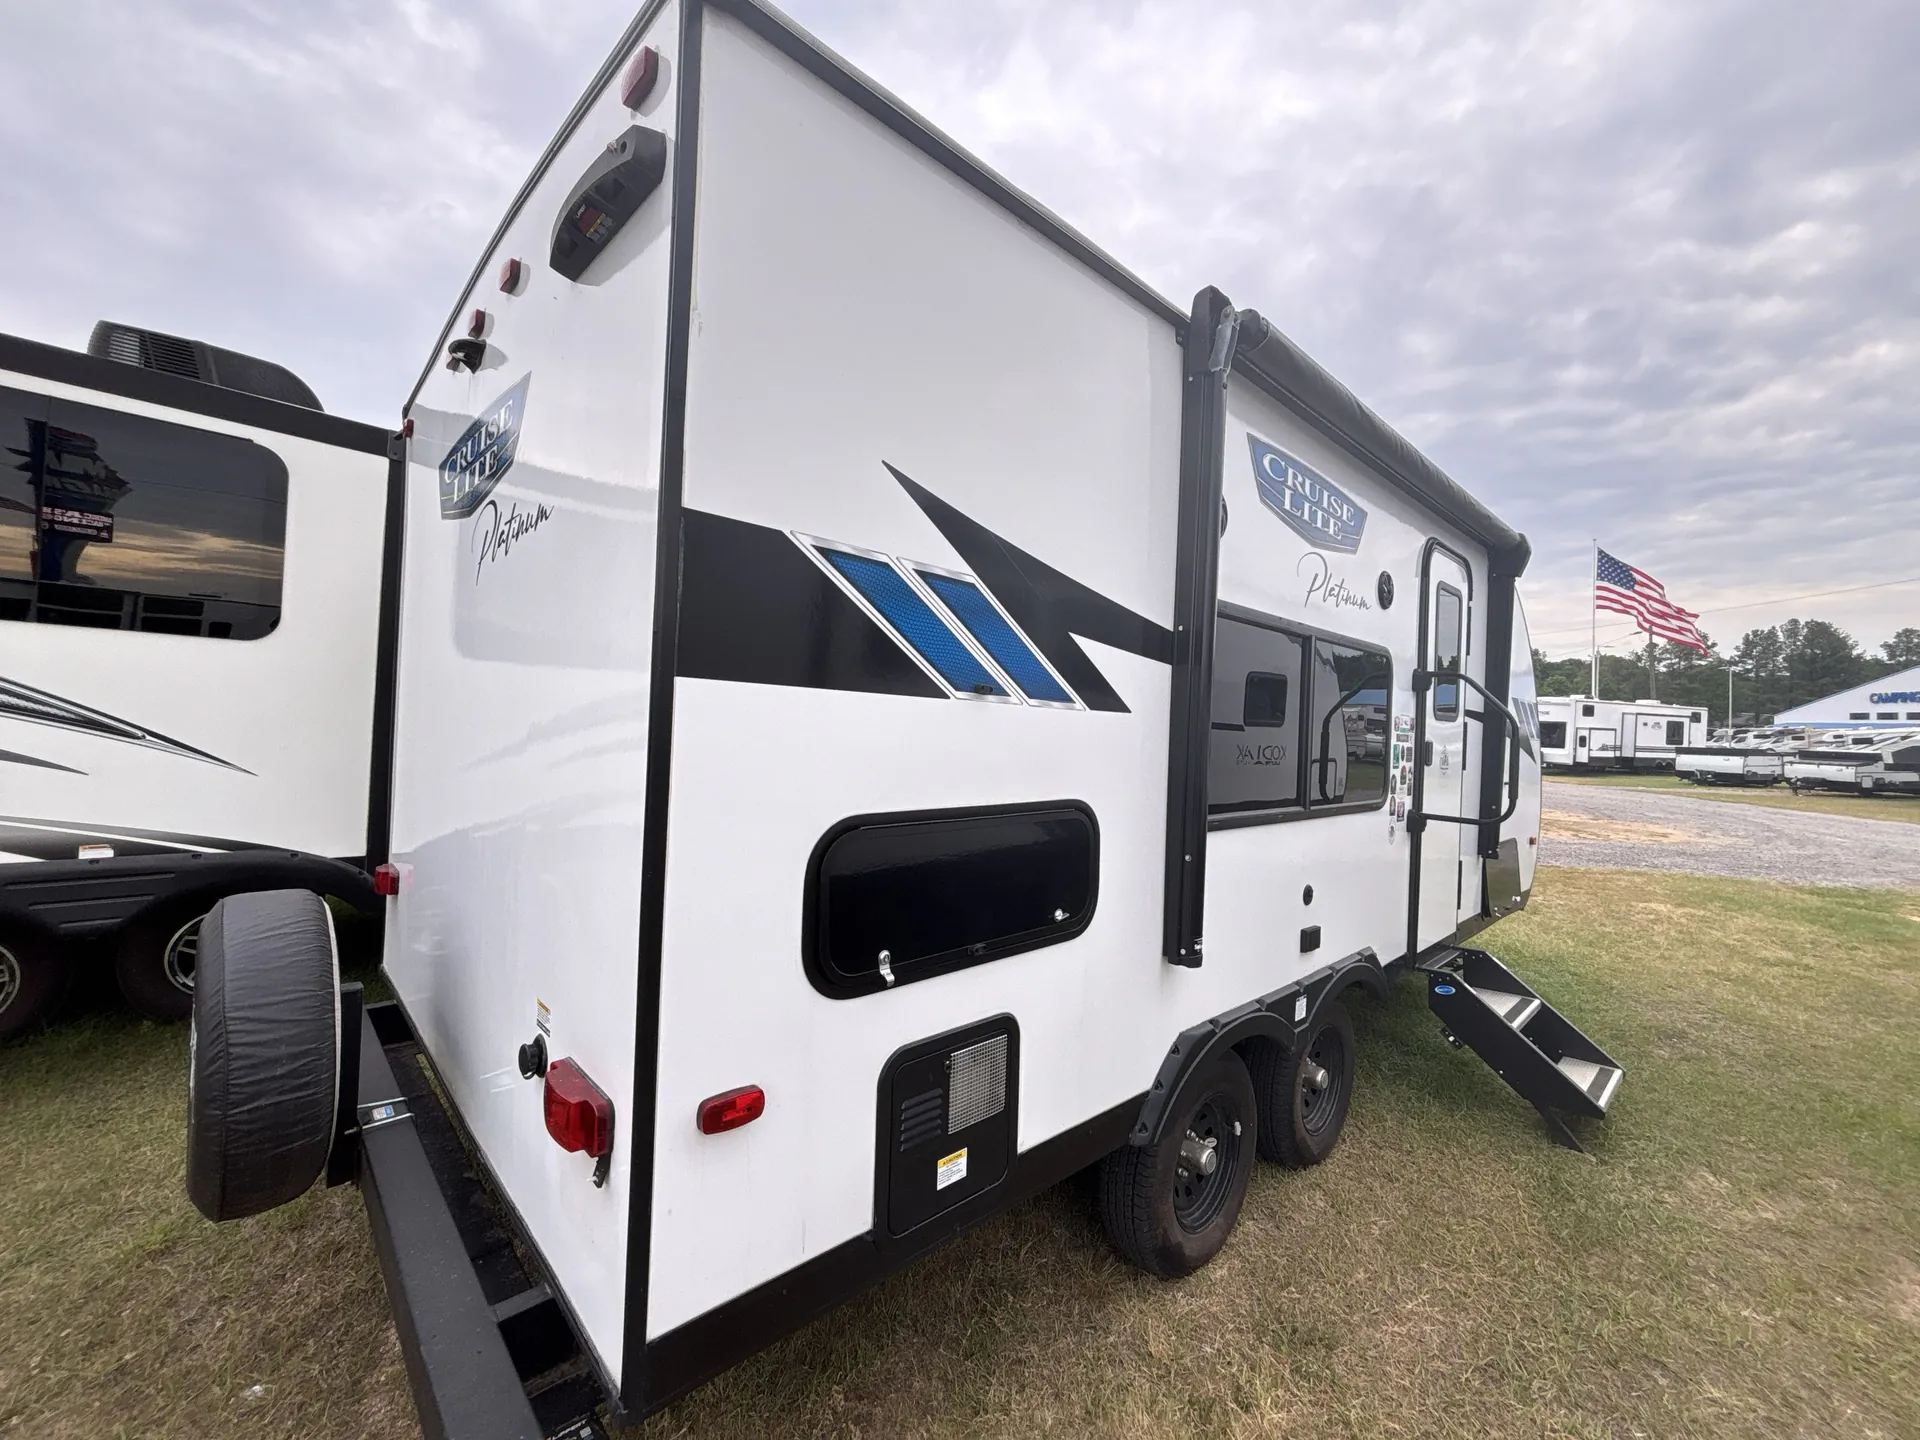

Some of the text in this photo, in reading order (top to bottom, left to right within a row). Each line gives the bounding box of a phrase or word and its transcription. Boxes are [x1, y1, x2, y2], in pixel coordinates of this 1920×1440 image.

[444, 399, 514, 484] CRUISE
[453, 444, 498, 504] LITE
[1262, 453, 1355, 526] CRUISE
[1282, 485, 1342, 540] LITE
[471, 499, 555, 587] Platinum
[1296, 551, 1372, 611] Platinum
